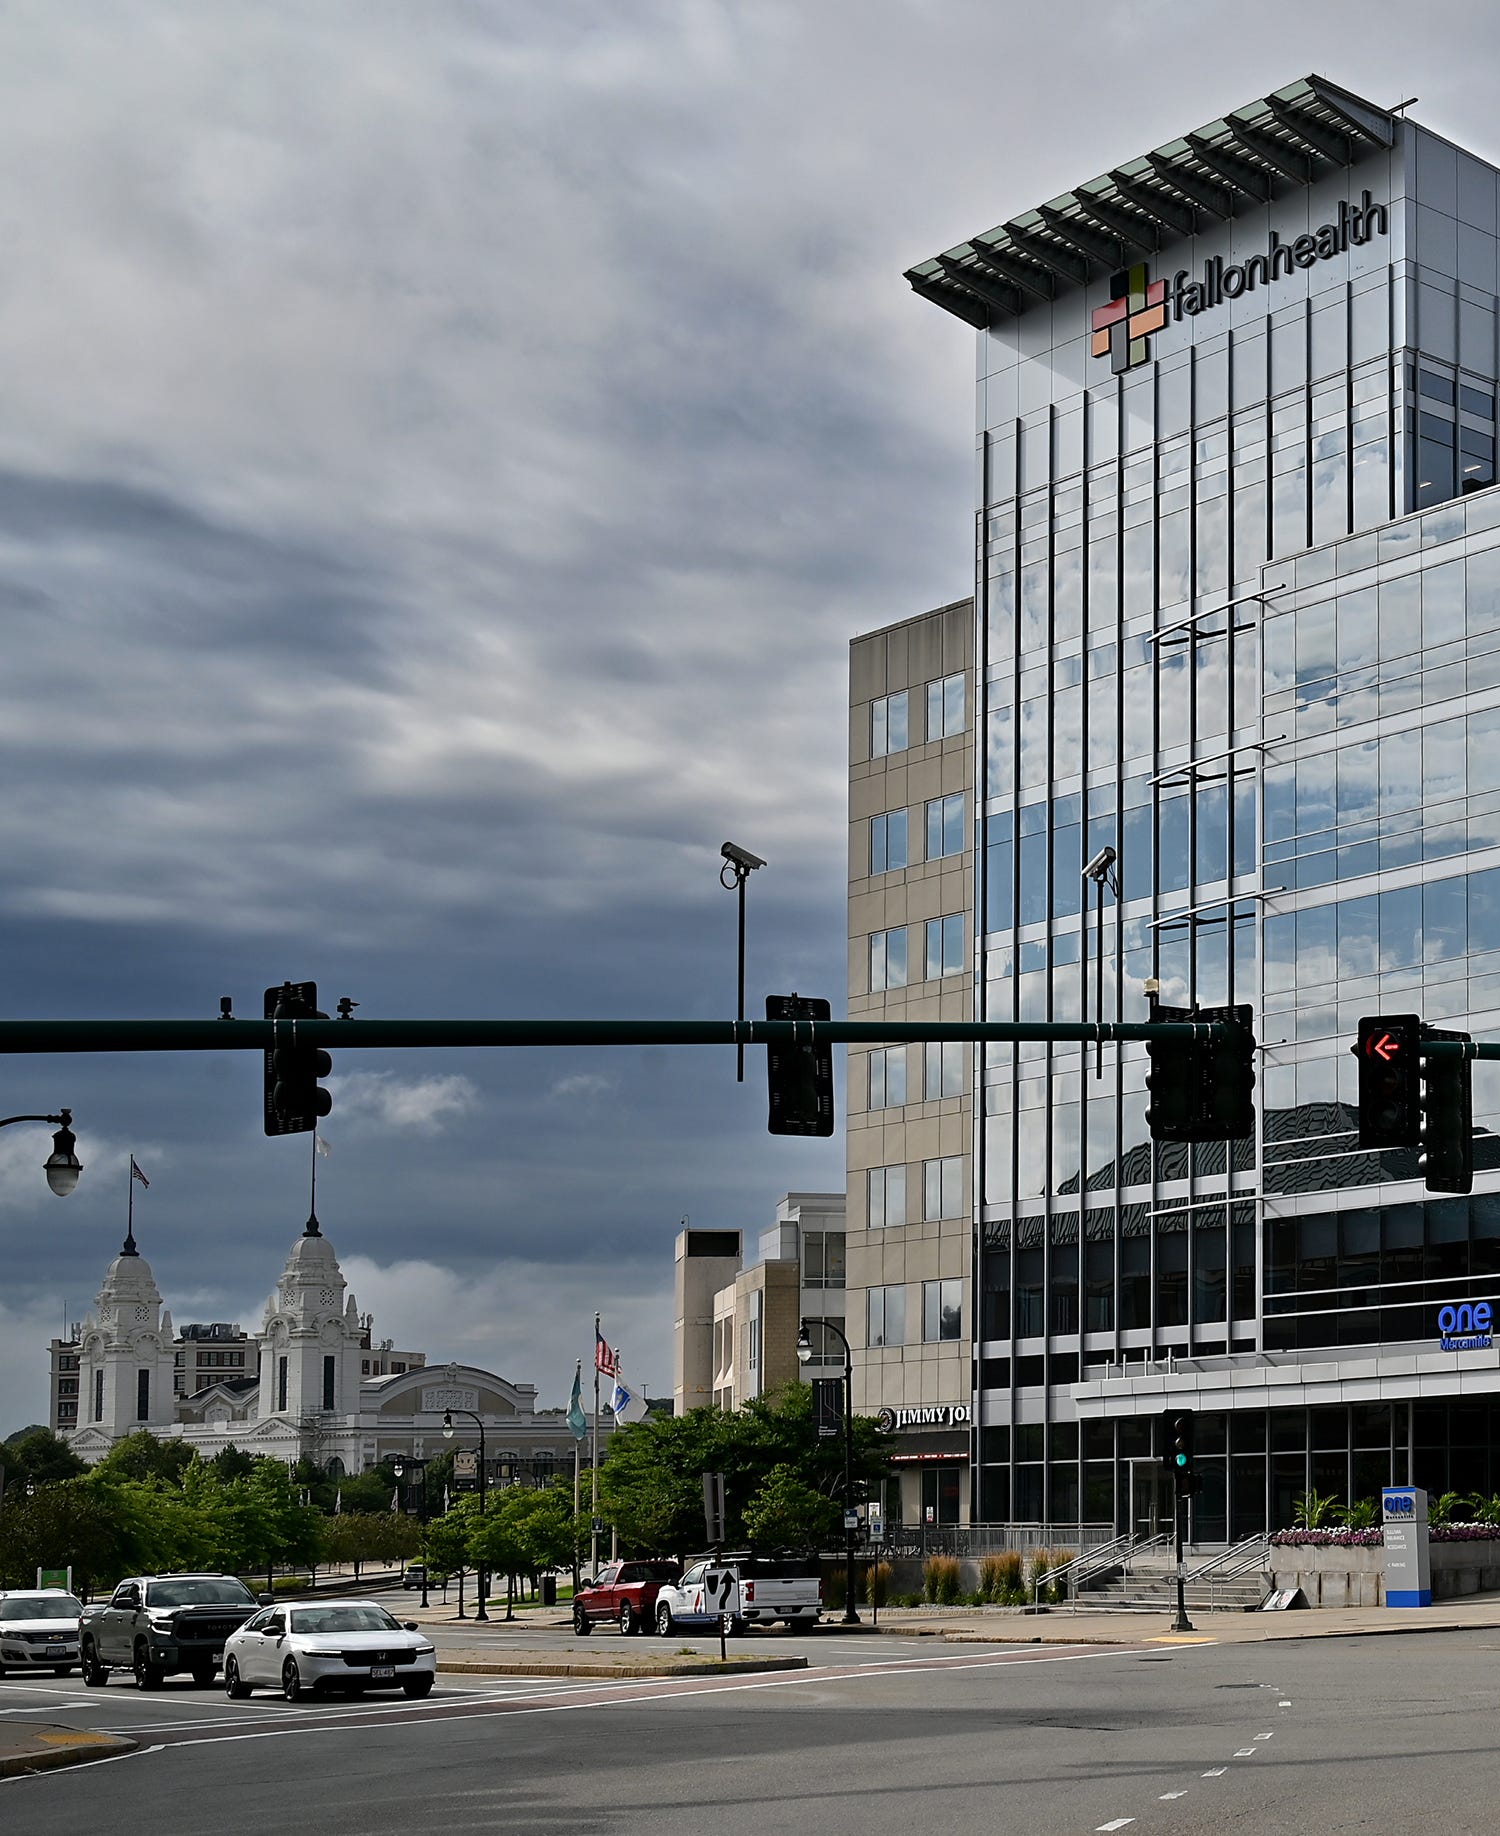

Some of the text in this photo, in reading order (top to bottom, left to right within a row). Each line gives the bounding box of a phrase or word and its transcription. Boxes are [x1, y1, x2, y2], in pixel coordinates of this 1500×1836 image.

[1168, 190, 1389, 321] fallonhealth
[1438, 1302, 1493, 1333] one
[1440, 1335, 1492, 1351] Mercantile
[896, 1407, 945, 1429] JIMMY
[1384, 1496, 1413, 1513] one
